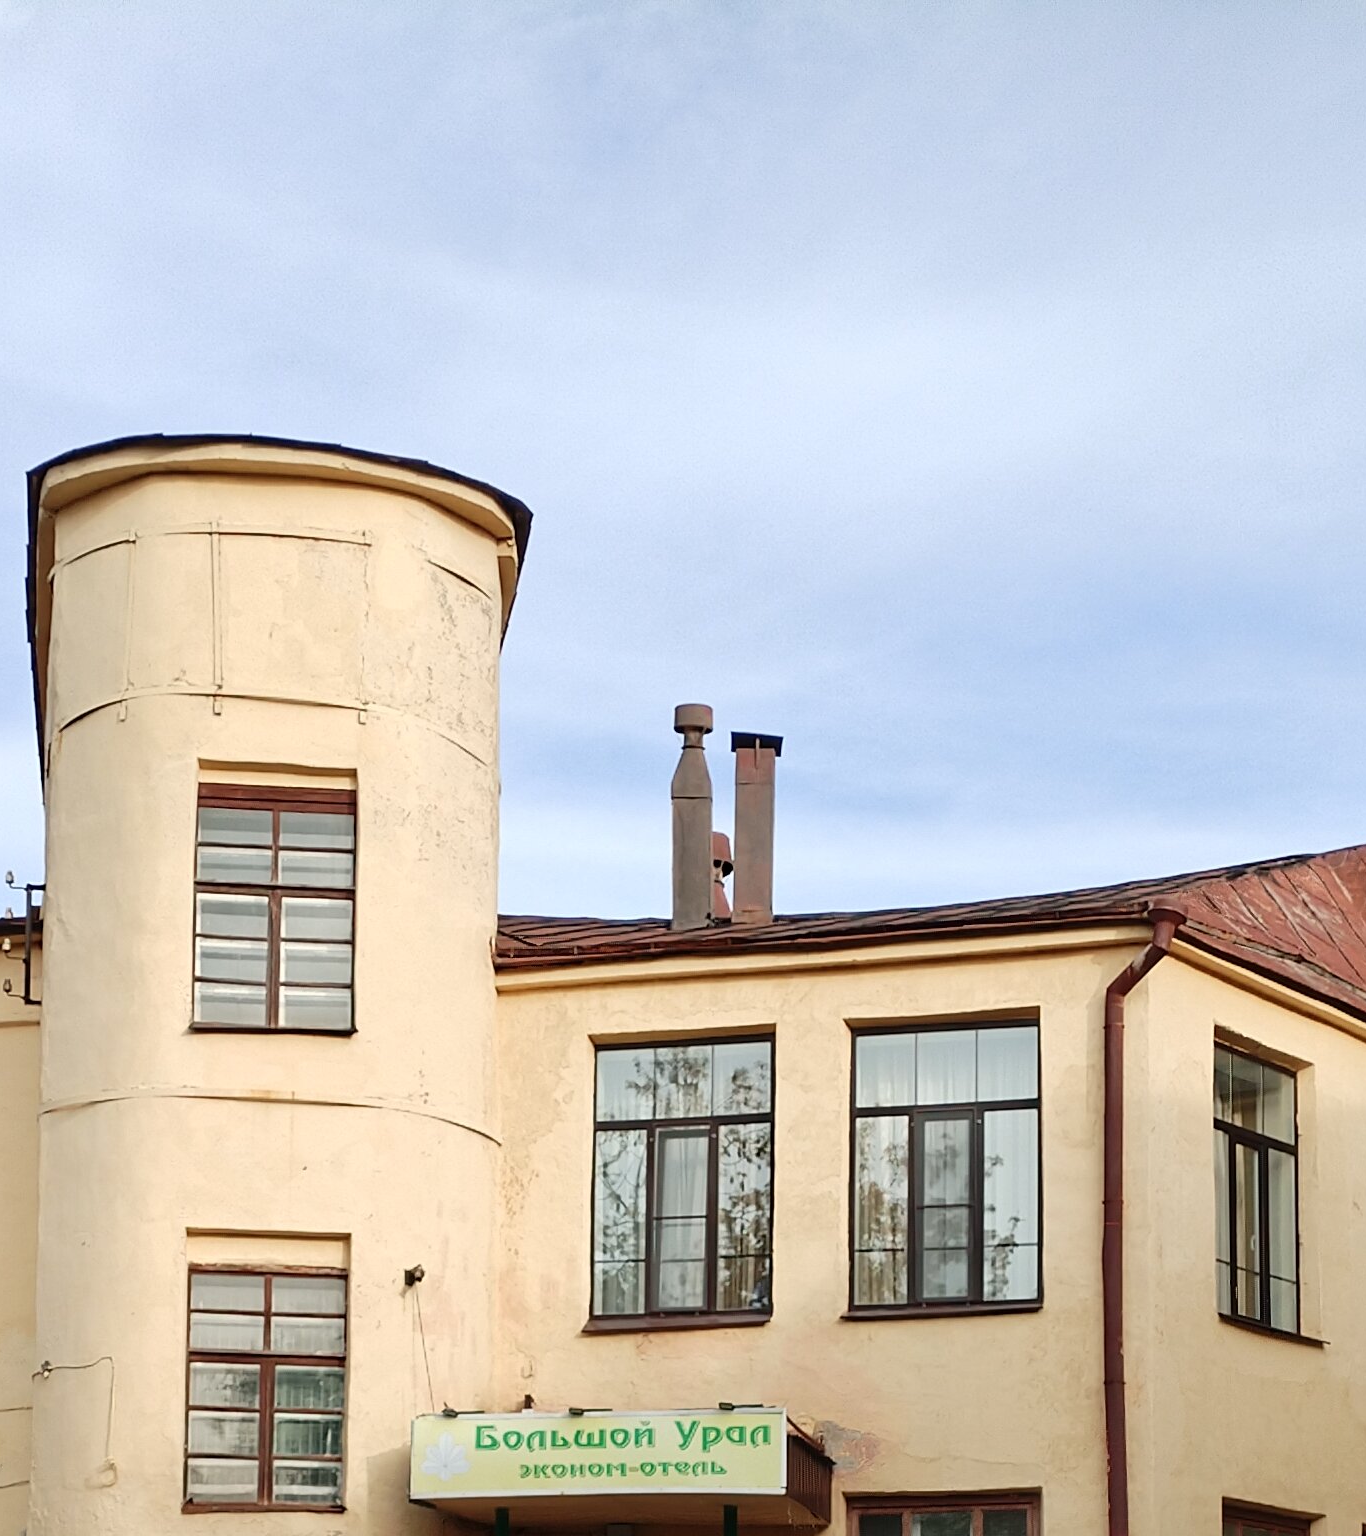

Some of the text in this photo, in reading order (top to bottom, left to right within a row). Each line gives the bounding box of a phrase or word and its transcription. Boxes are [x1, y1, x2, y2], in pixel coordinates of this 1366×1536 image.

[475, 1420, 772, 1453] Большой Урал
[520, 1460, 728, 1478] эконом-отель
